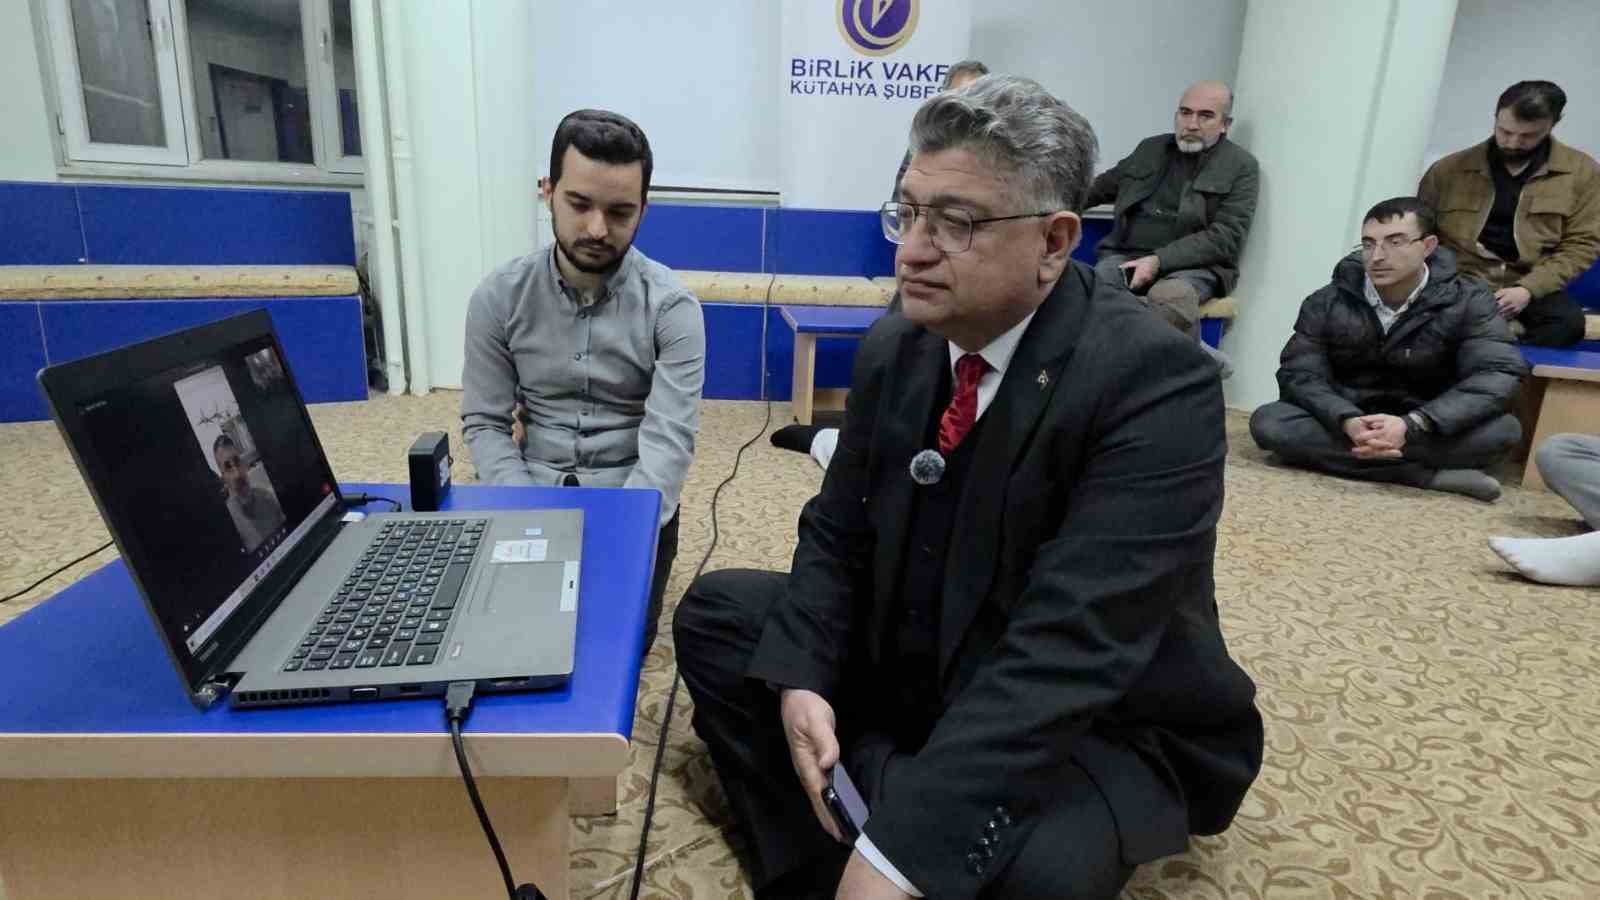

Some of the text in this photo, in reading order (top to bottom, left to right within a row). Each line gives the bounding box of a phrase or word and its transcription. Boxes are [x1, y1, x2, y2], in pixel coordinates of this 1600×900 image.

[882, 61, 950, 83] VAKF
[790, 80, 945, 100] KÜTAHYA ŞUBE
